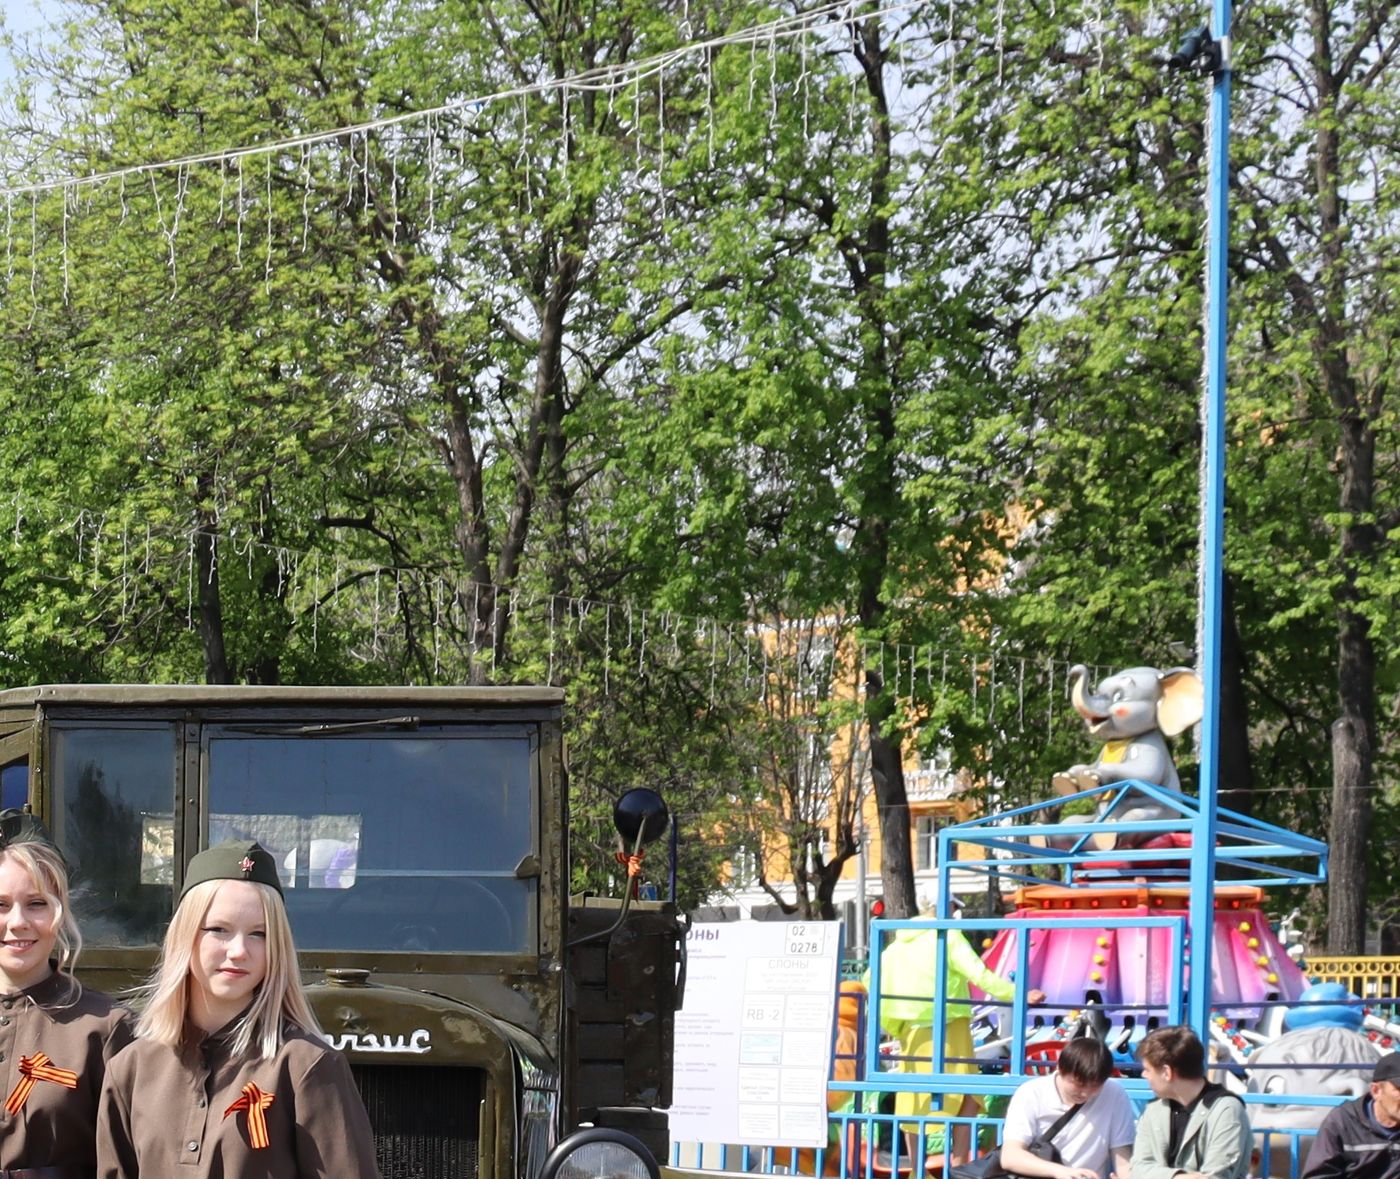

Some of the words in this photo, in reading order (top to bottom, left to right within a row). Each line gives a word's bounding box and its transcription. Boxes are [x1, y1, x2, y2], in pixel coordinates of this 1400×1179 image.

[792, 925, 805, 936] 02
[791, 942, 817, 953] 0278
[768, 959, 809, 969] СЛОНЫ
